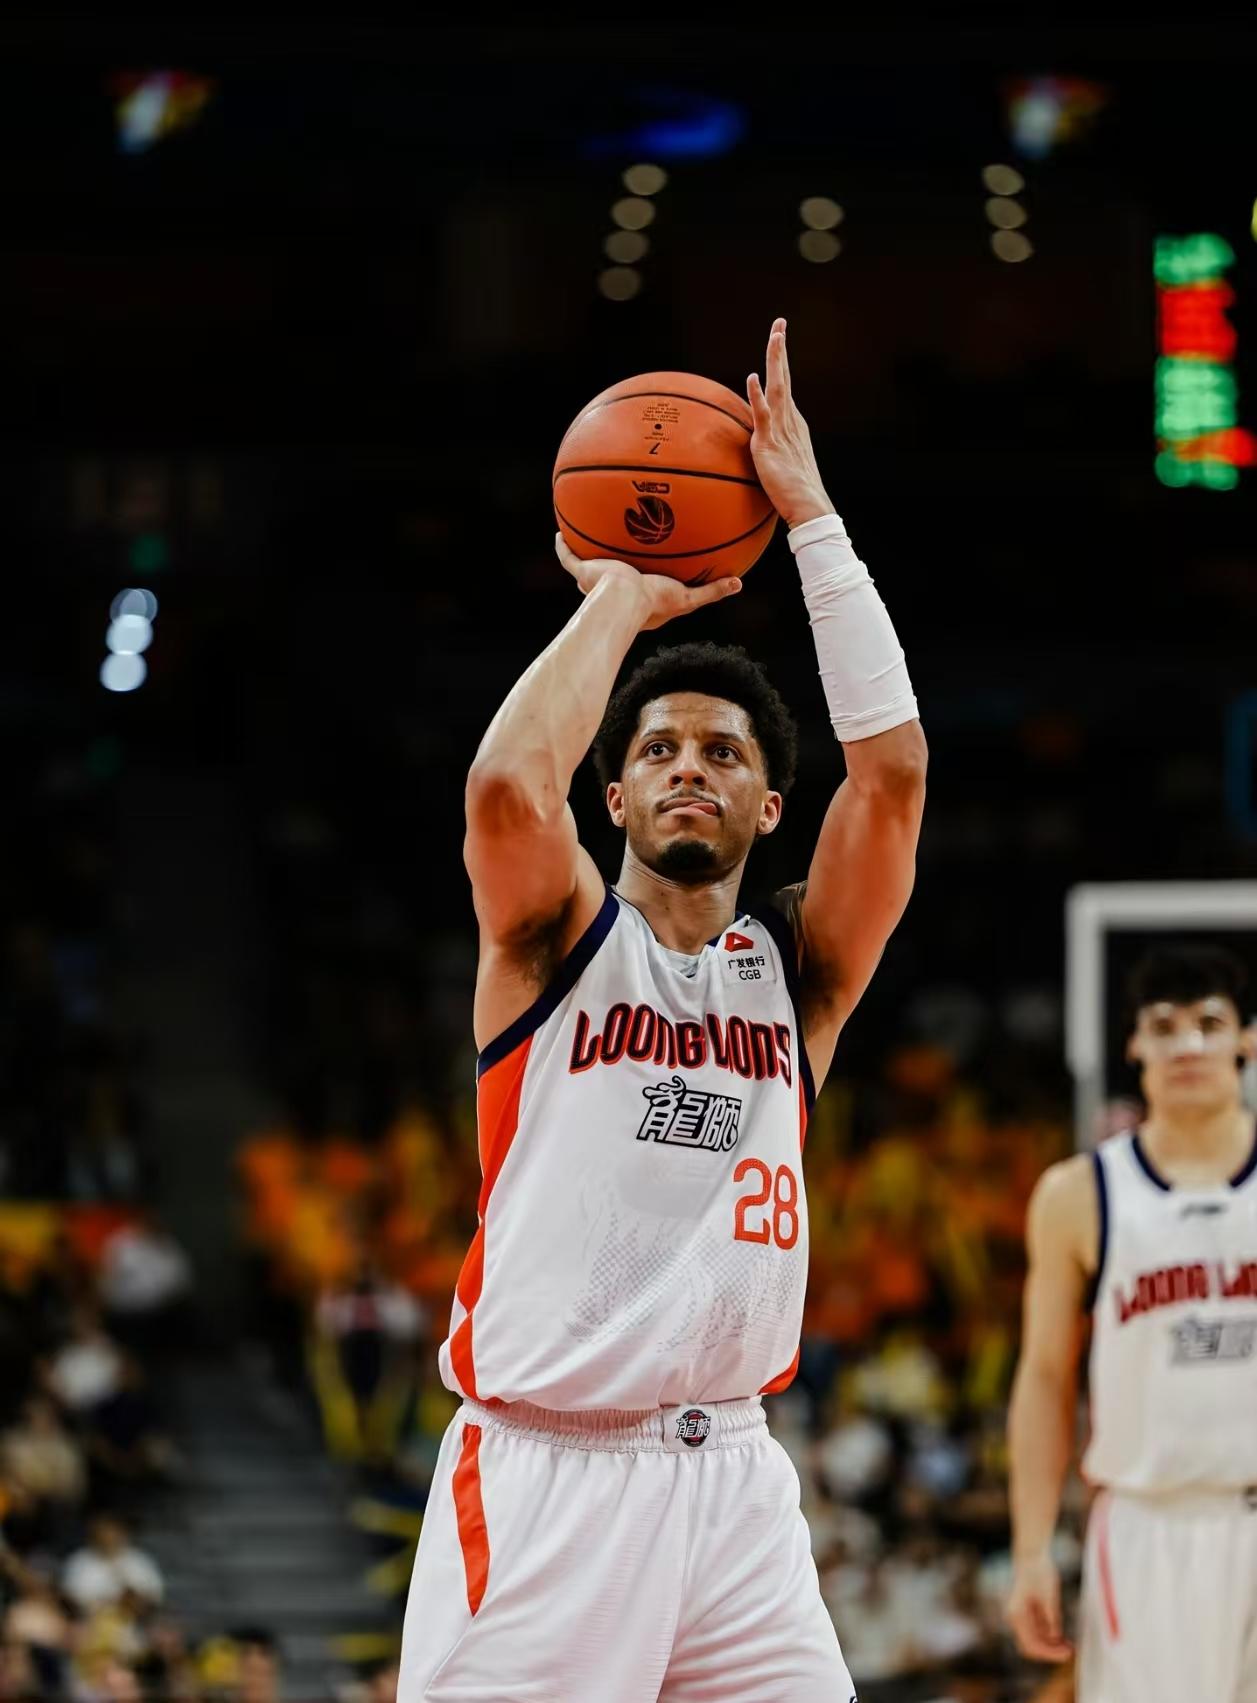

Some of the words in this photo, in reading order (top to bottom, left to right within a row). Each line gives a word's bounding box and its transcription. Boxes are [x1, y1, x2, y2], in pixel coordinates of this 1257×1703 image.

[649, 442, 661, 455] 7
[727, 955, 765, 969] 广发银行
[738, 969, 762, 980] CGB
[568, 1002, 707, 1074] LOONG
[706, 1013, 792, 1089] LONS
[732, 1157, 799, 1250] 28
